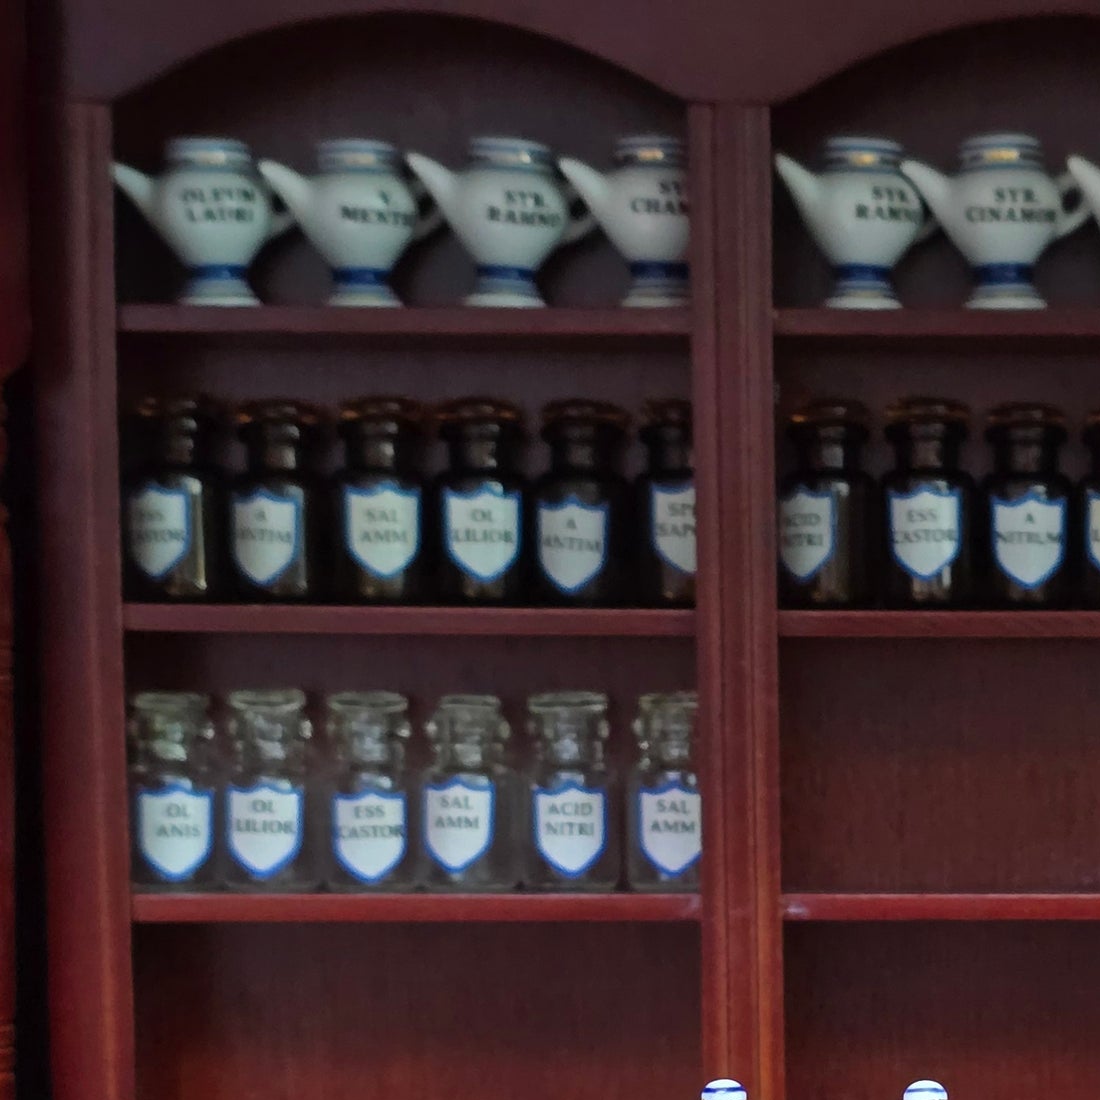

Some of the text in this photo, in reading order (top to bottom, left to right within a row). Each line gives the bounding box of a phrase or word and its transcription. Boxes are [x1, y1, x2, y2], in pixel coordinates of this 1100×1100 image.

[905, 510, 937, 523] ESS
[253, 799, 276, 814] OL
[440, 795, 473, 810] SAL
[546, 801, 590, 817] ACID
[656, 799, 690, 814] SAL
[168, 803, 190, 818] OL
[355, 805, 386, 819] ESS
[435, 815, 479, 830] AMM
[650, 820, 695, 835] AMM
[157, 824, 200, 838] ANIS
